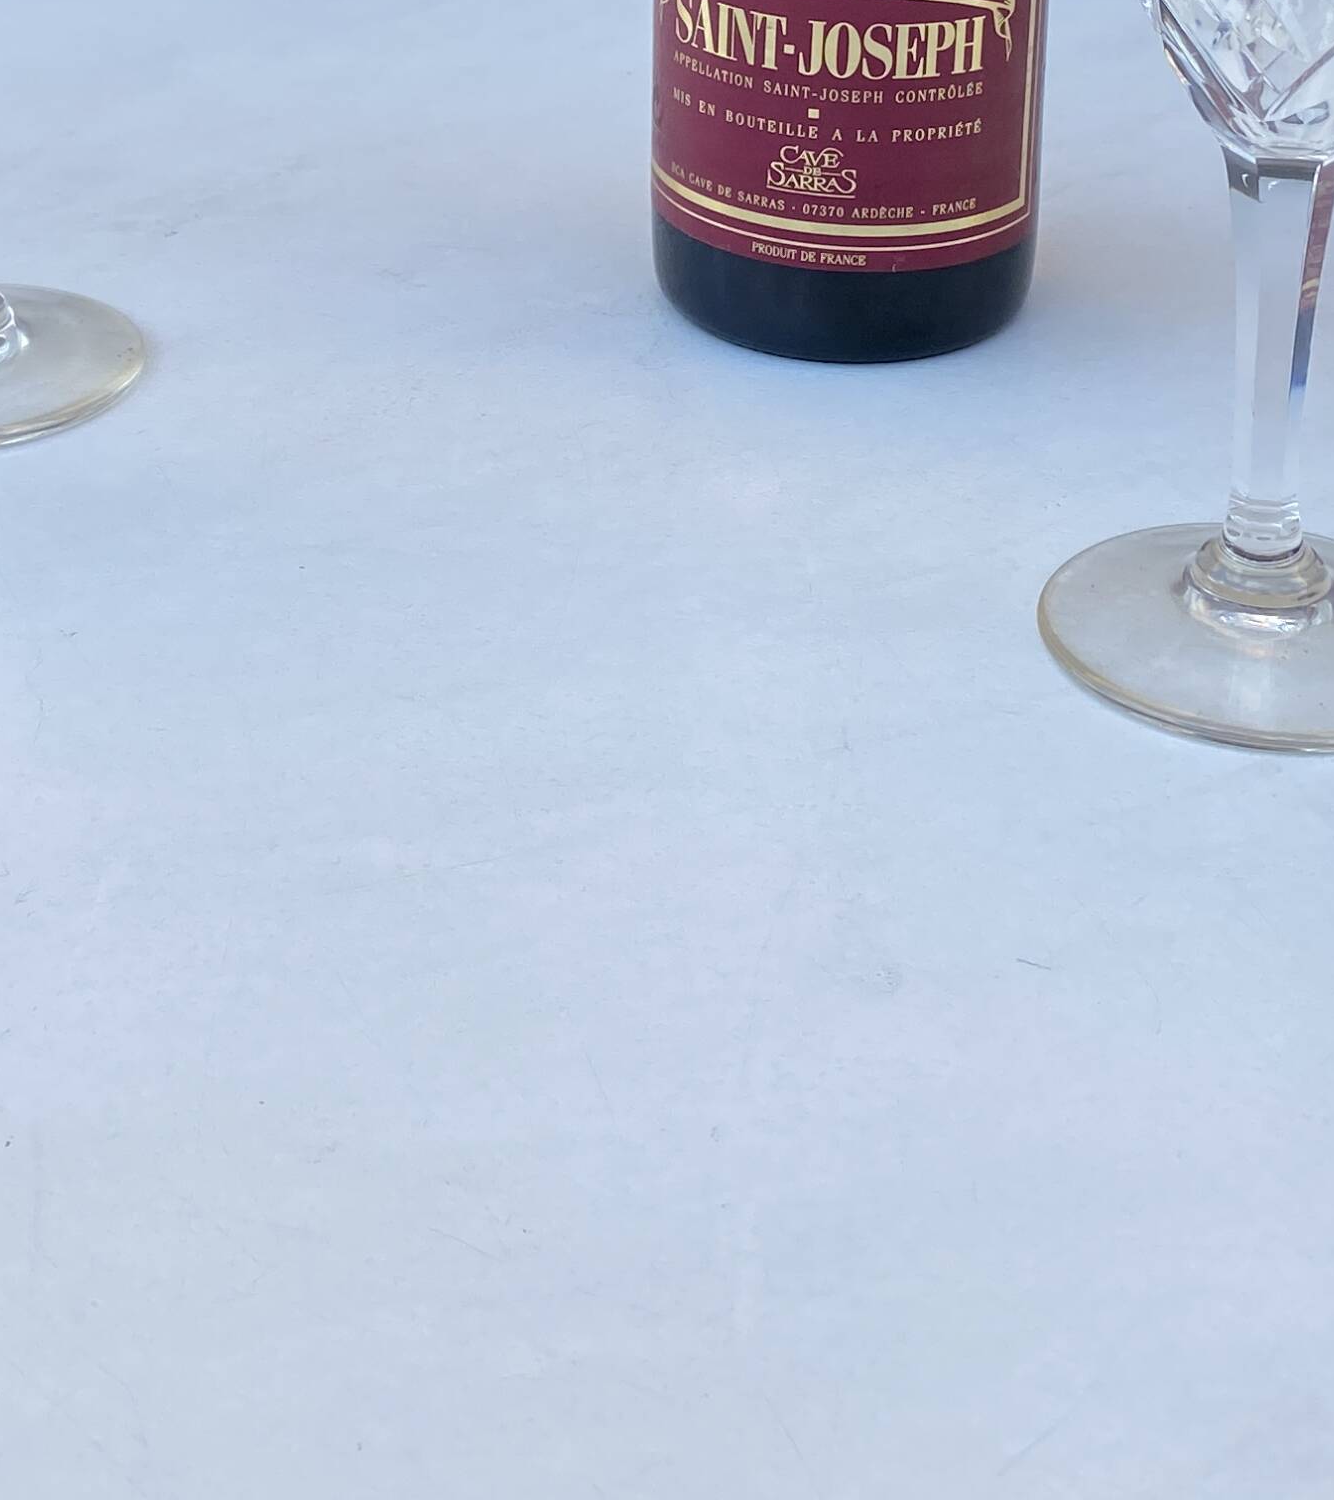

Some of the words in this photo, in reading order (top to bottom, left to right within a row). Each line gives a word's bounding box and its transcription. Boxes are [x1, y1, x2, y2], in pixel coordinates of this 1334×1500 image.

[673, 51, 753, 89] APPELLATION
[763, 79, 884, 104] SAINT-JOSEPH
[895, 81, 984, 104] CONTRÔLÉE
[673, 86, 691, 106] MIS
[698, 99, 716, 117] EN
[725, 109, 818, 140] BOUTEILLE
[831, 128, 843, 142] A
[856, 129, 879, 143] LA
[891, 117, 983, 143] PROPRIÉTÉ
[779, 145, 844, 169] CAVE
[803, 165, 821, 176] DE
[767, 161, 857, 194] SARRAS
[688, 172, 713, 193] CAVE
[717, 183, 732, 199] DE
[737, 190, 785, 211] SARRAS
[802, 203, 844, 218] 07370
[932, 198, 976, 216] FRANCE
[751, 241, 797, 260] PRODUIT
[800, 251, 816, 263] DE
[820, 253, 867, 267] FRANCE
